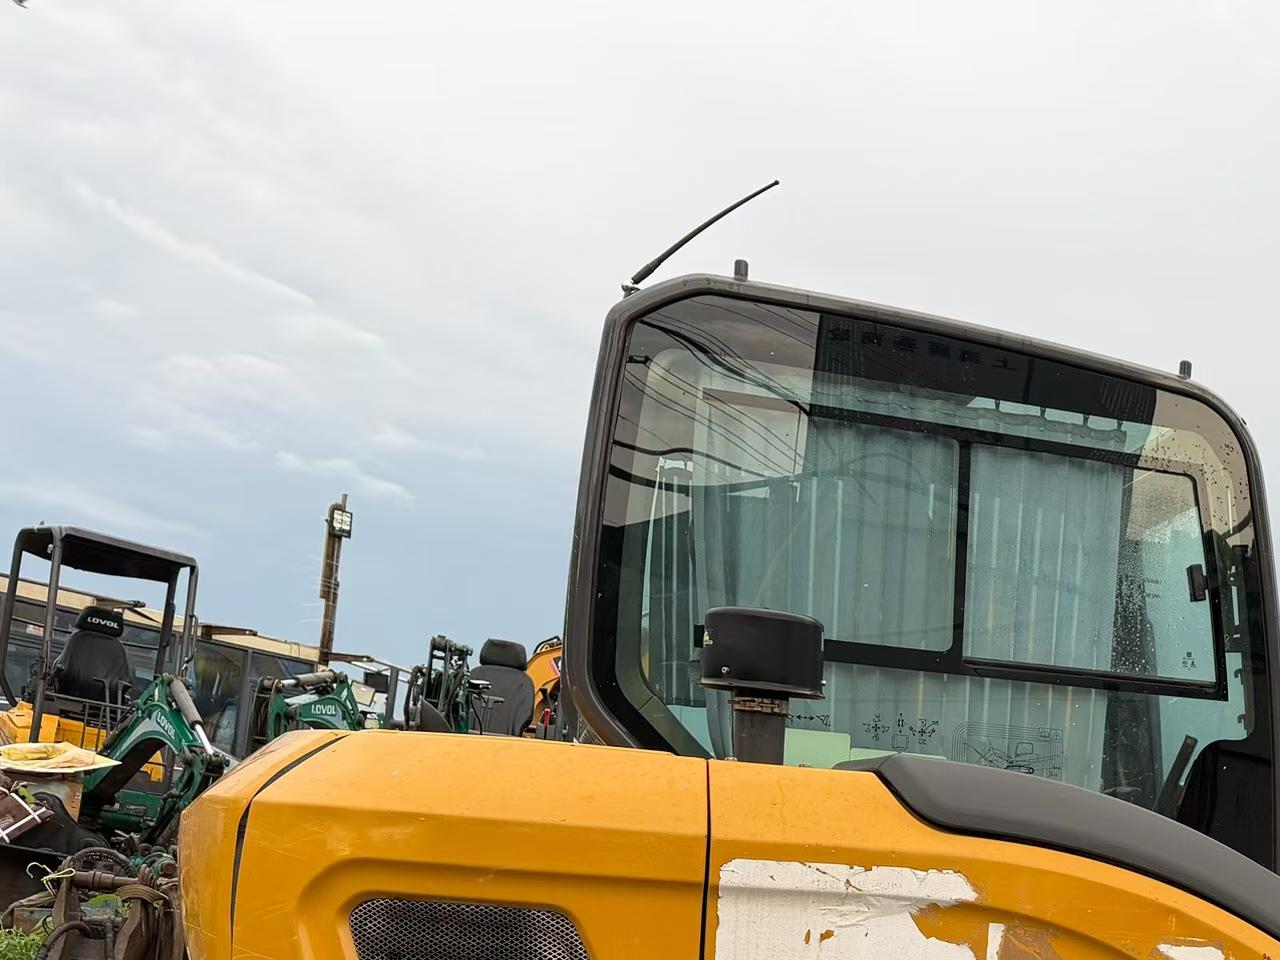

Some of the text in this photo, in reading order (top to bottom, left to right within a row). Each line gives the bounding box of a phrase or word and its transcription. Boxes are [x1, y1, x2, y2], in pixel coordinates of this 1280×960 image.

[87, 616, 120, 629] LOVOL
[311, 704, 337, 715] LOVOL
[156, 711, 176, 740] LOVOL
